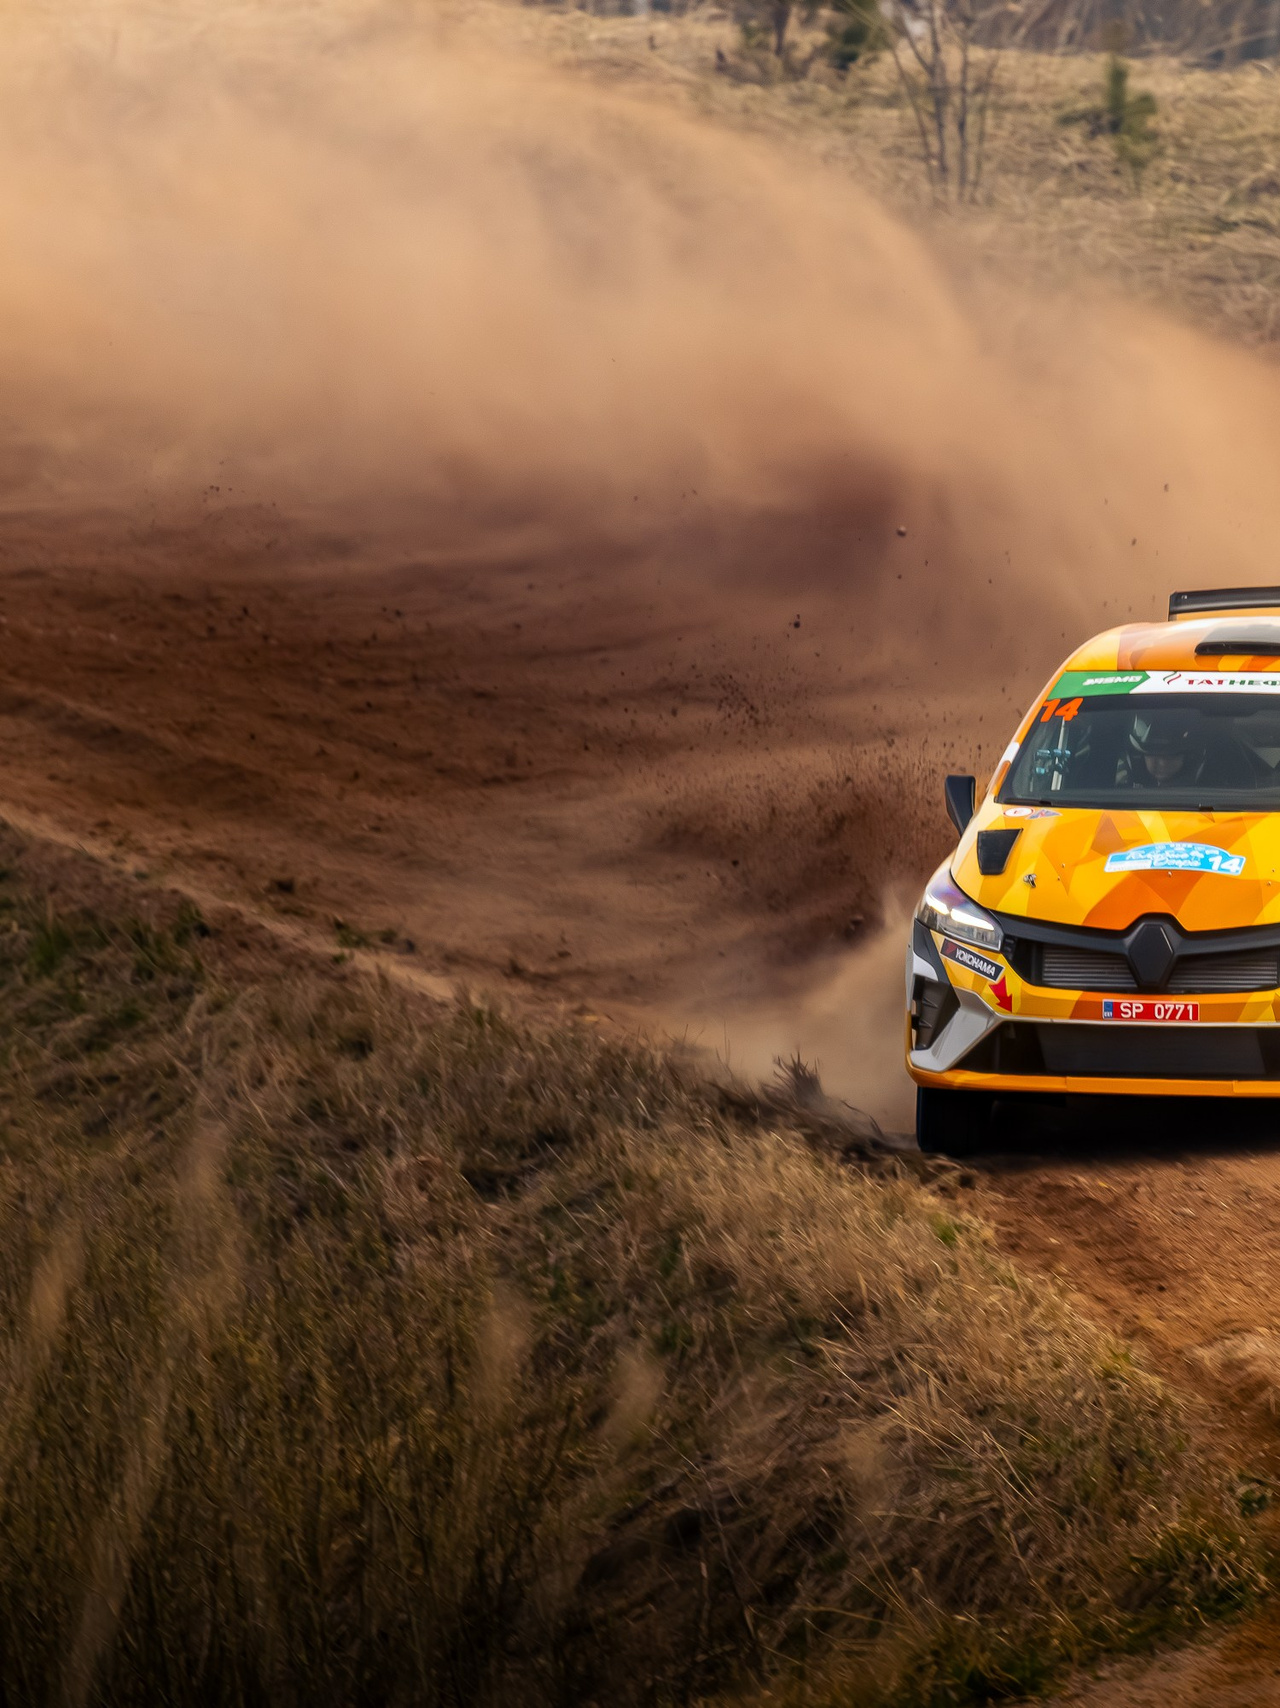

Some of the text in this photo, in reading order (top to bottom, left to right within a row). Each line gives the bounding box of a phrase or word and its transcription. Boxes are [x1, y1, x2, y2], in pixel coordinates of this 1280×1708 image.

[1040, 697, 1083, 722] 14
[1209, 855, 1241, 873] 14
[956, 948, 995, 976] YOKOHAMA
[1120, 1002, 1193, 1020] SP 0771
